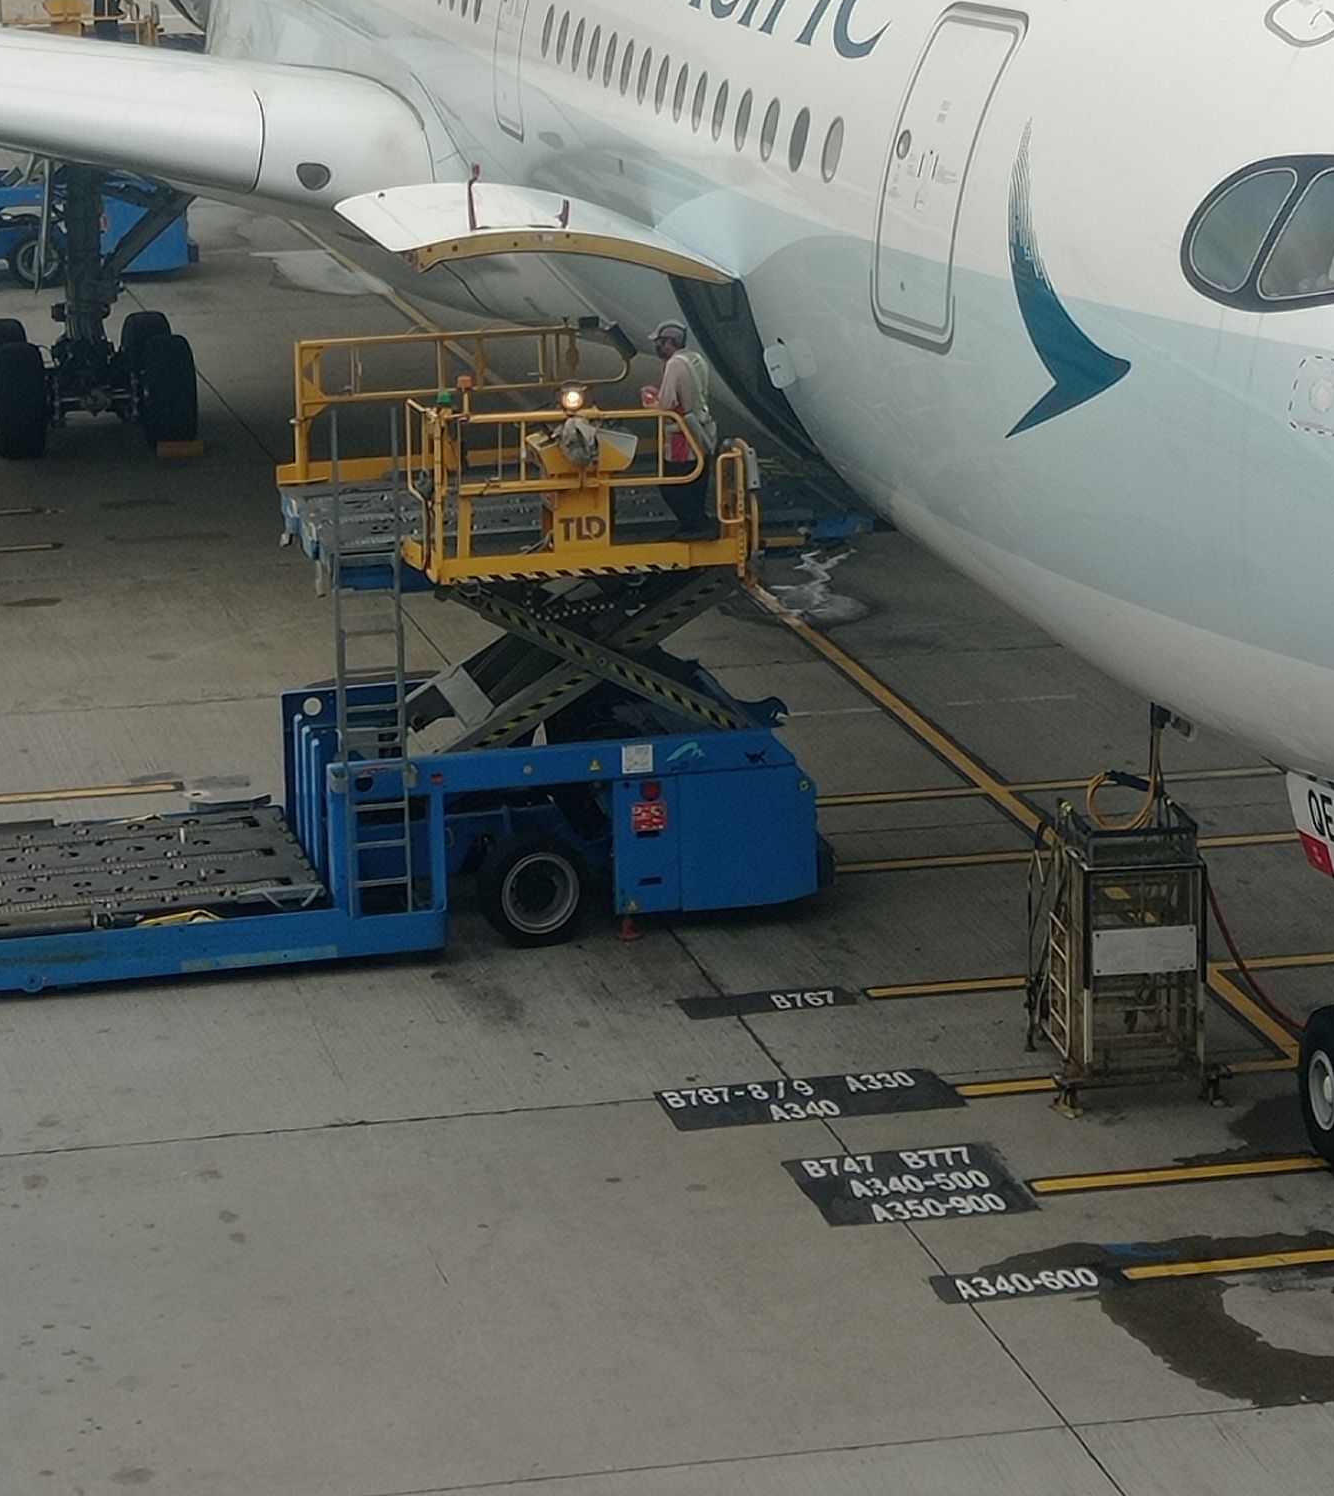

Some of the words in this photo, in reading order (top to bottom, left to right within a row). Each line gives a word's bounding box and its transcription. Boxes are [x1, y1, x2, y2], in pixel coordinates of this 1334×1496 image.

[558, 514, 607, 542] TLD
[770, 989, 836, 1010] B767
[844, 1071, 916, 1093] A330
[769, 1099, 841, 1121] A340
[801, 1155, 875, 1178] B747
[899, 1146, 971, 1169] B777
[850, 1169, 991, 1198] A340-500
[872, 1193, 1007, 1222] A350-900
[955, 1267, 1099, 1300] A340-600
